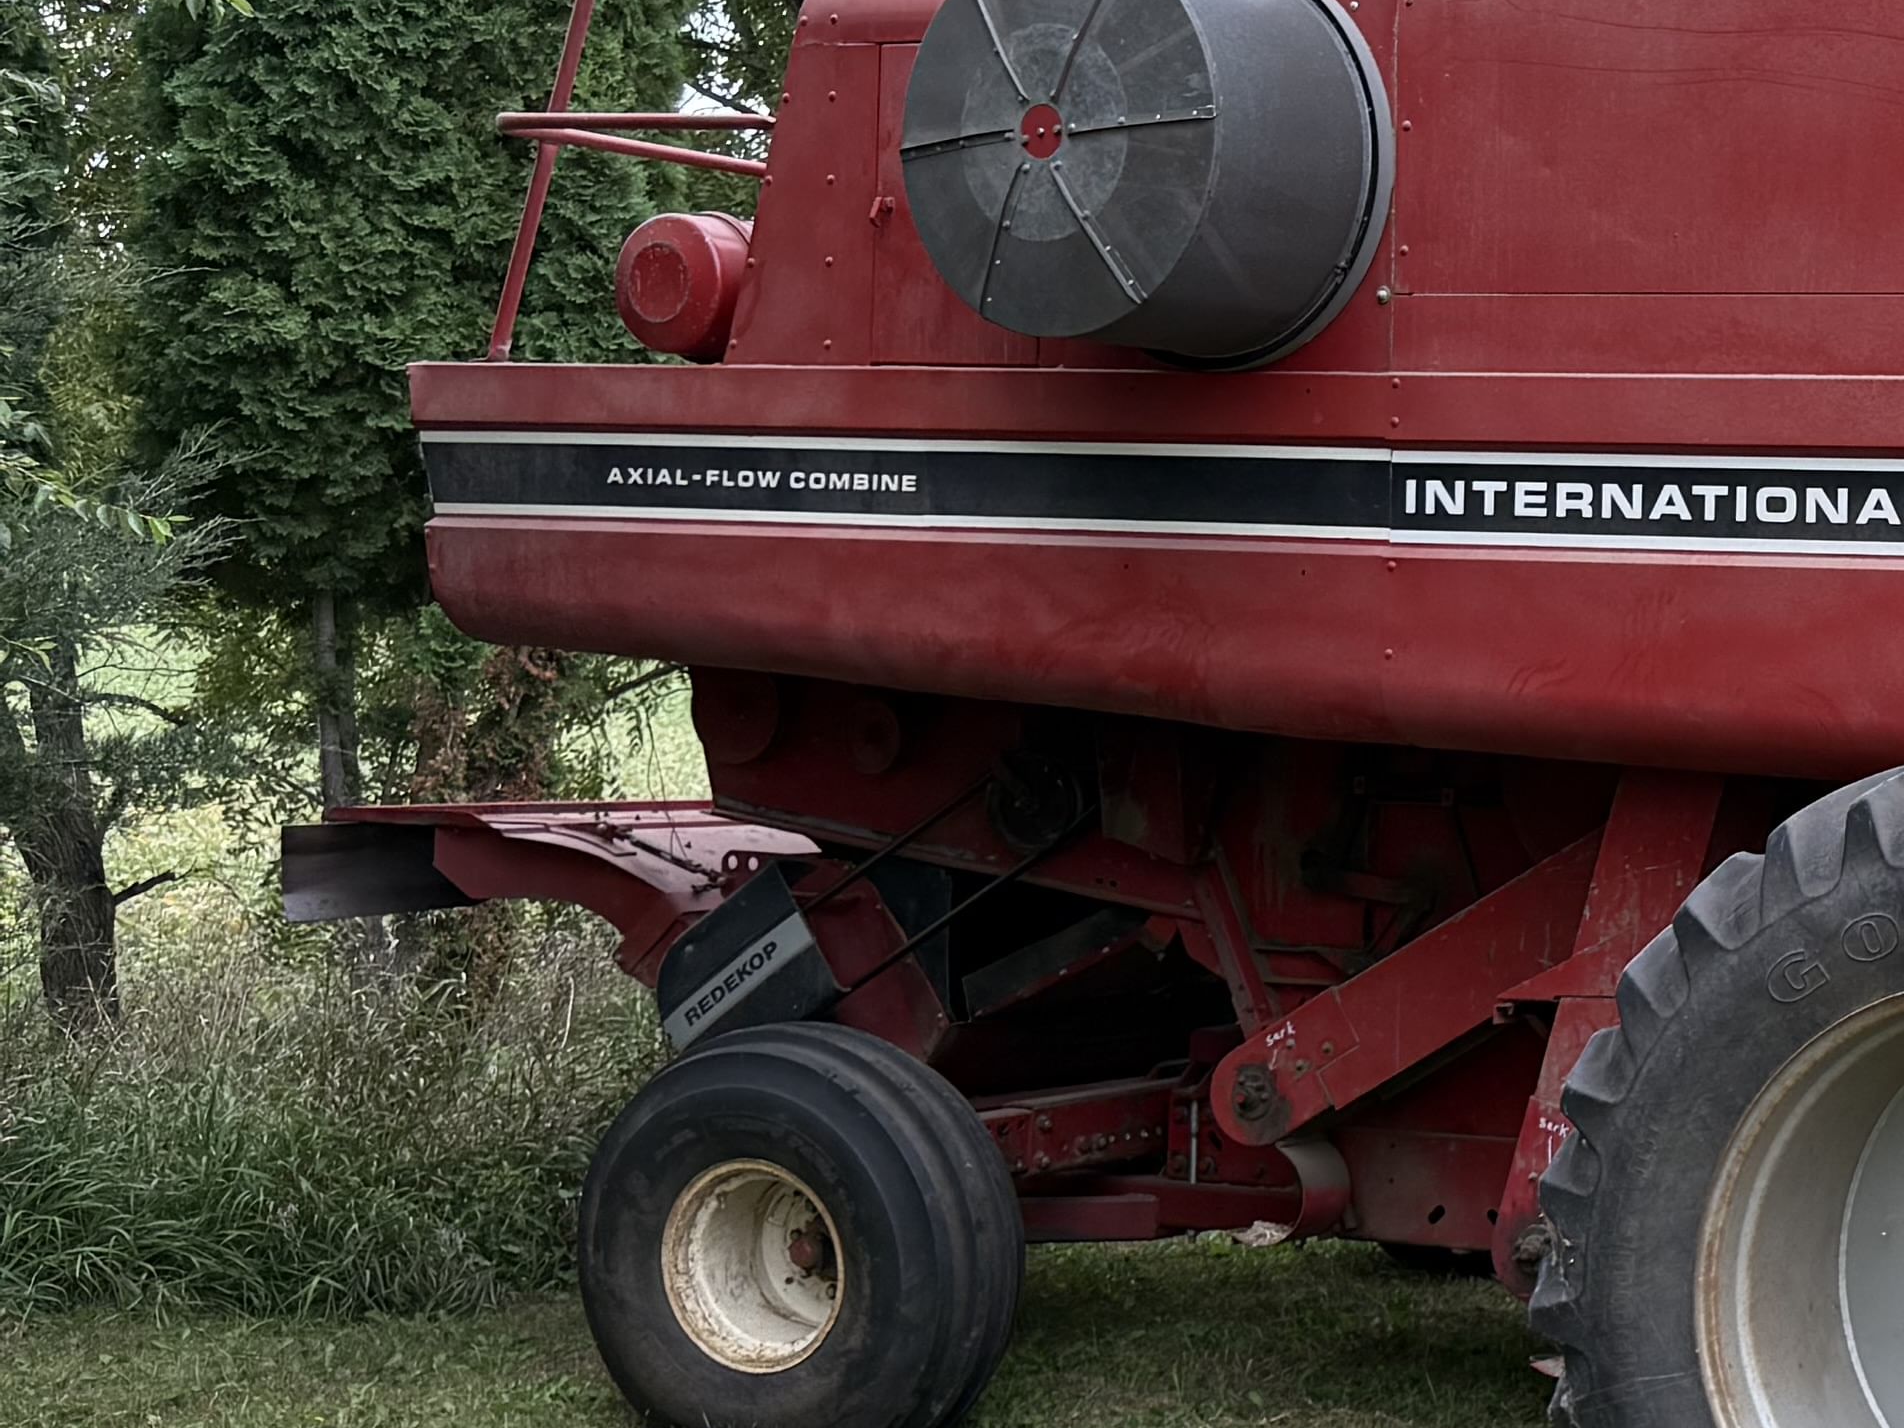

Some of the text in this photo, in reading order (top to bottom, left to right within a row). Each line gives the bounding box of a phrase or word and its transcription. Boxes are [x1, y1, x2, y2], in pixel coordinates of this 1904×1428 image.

[606, 467, 918, 492] AXIAL-FLOW COMBINE
[684, 940, 778, 1027] REDEKOP
